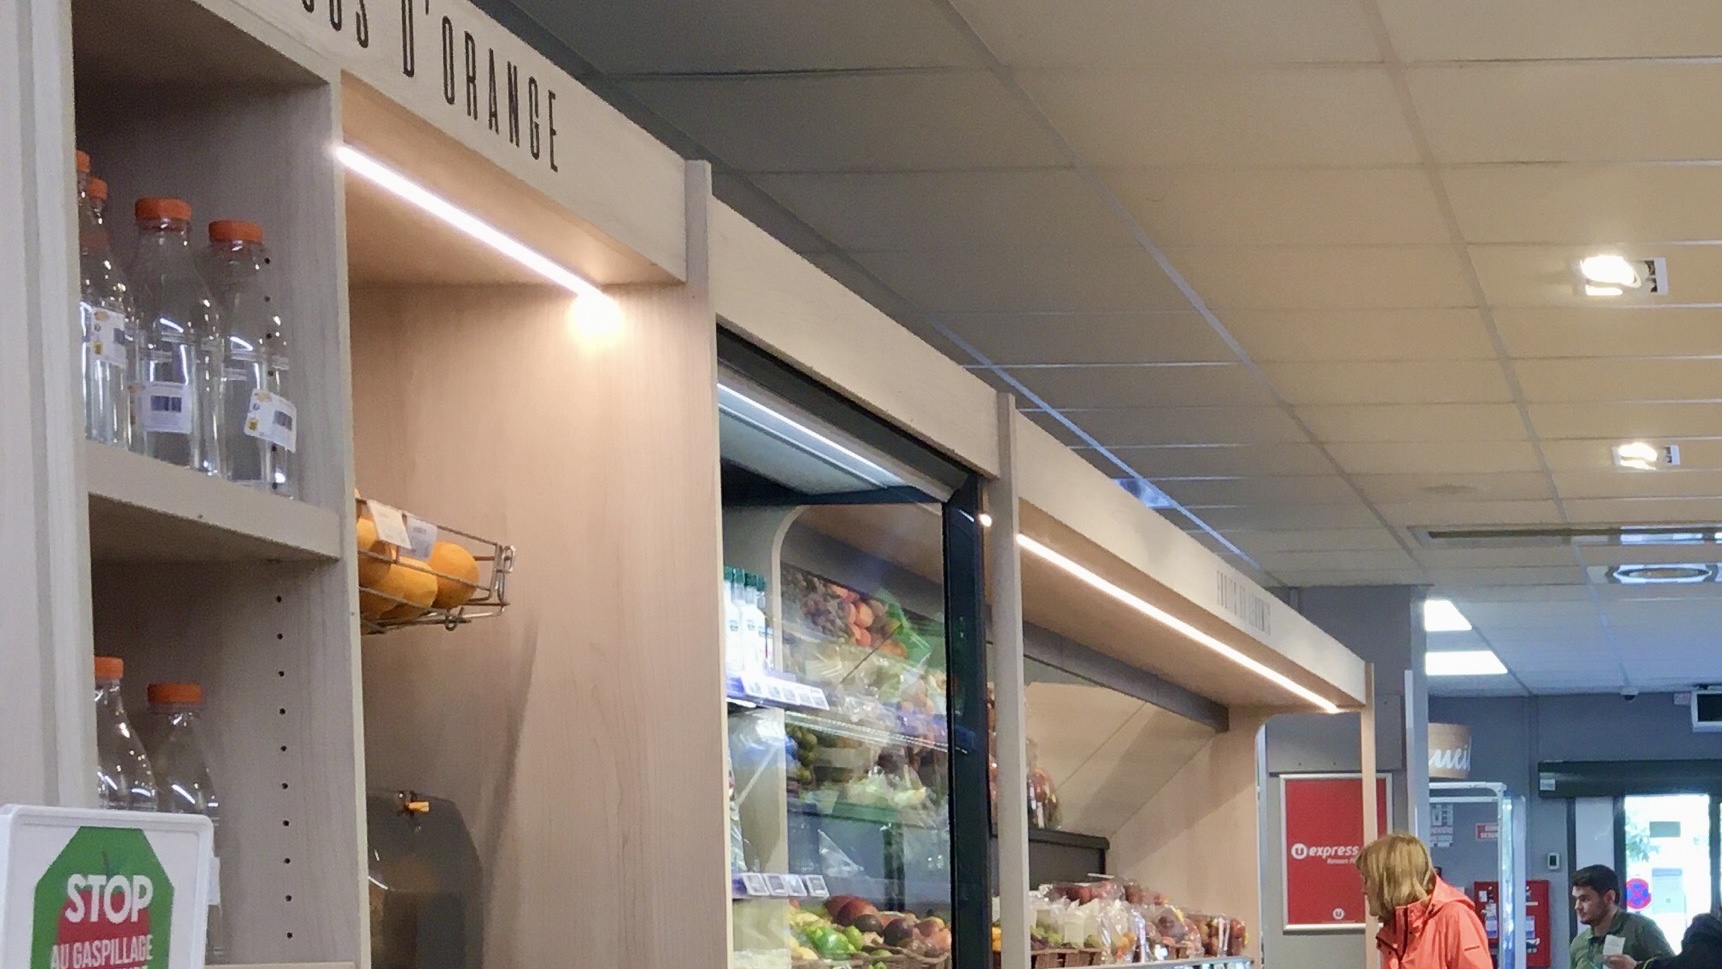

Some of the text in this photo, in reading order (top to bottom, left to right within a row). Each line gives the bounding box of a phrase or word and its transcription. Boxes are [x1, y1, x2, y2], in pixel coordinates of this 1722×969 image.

[1308, 845, 1360, 859] express
[64, 873, 153, 924] STOP
[73, 934, 153, 969] GASPILLAGE
